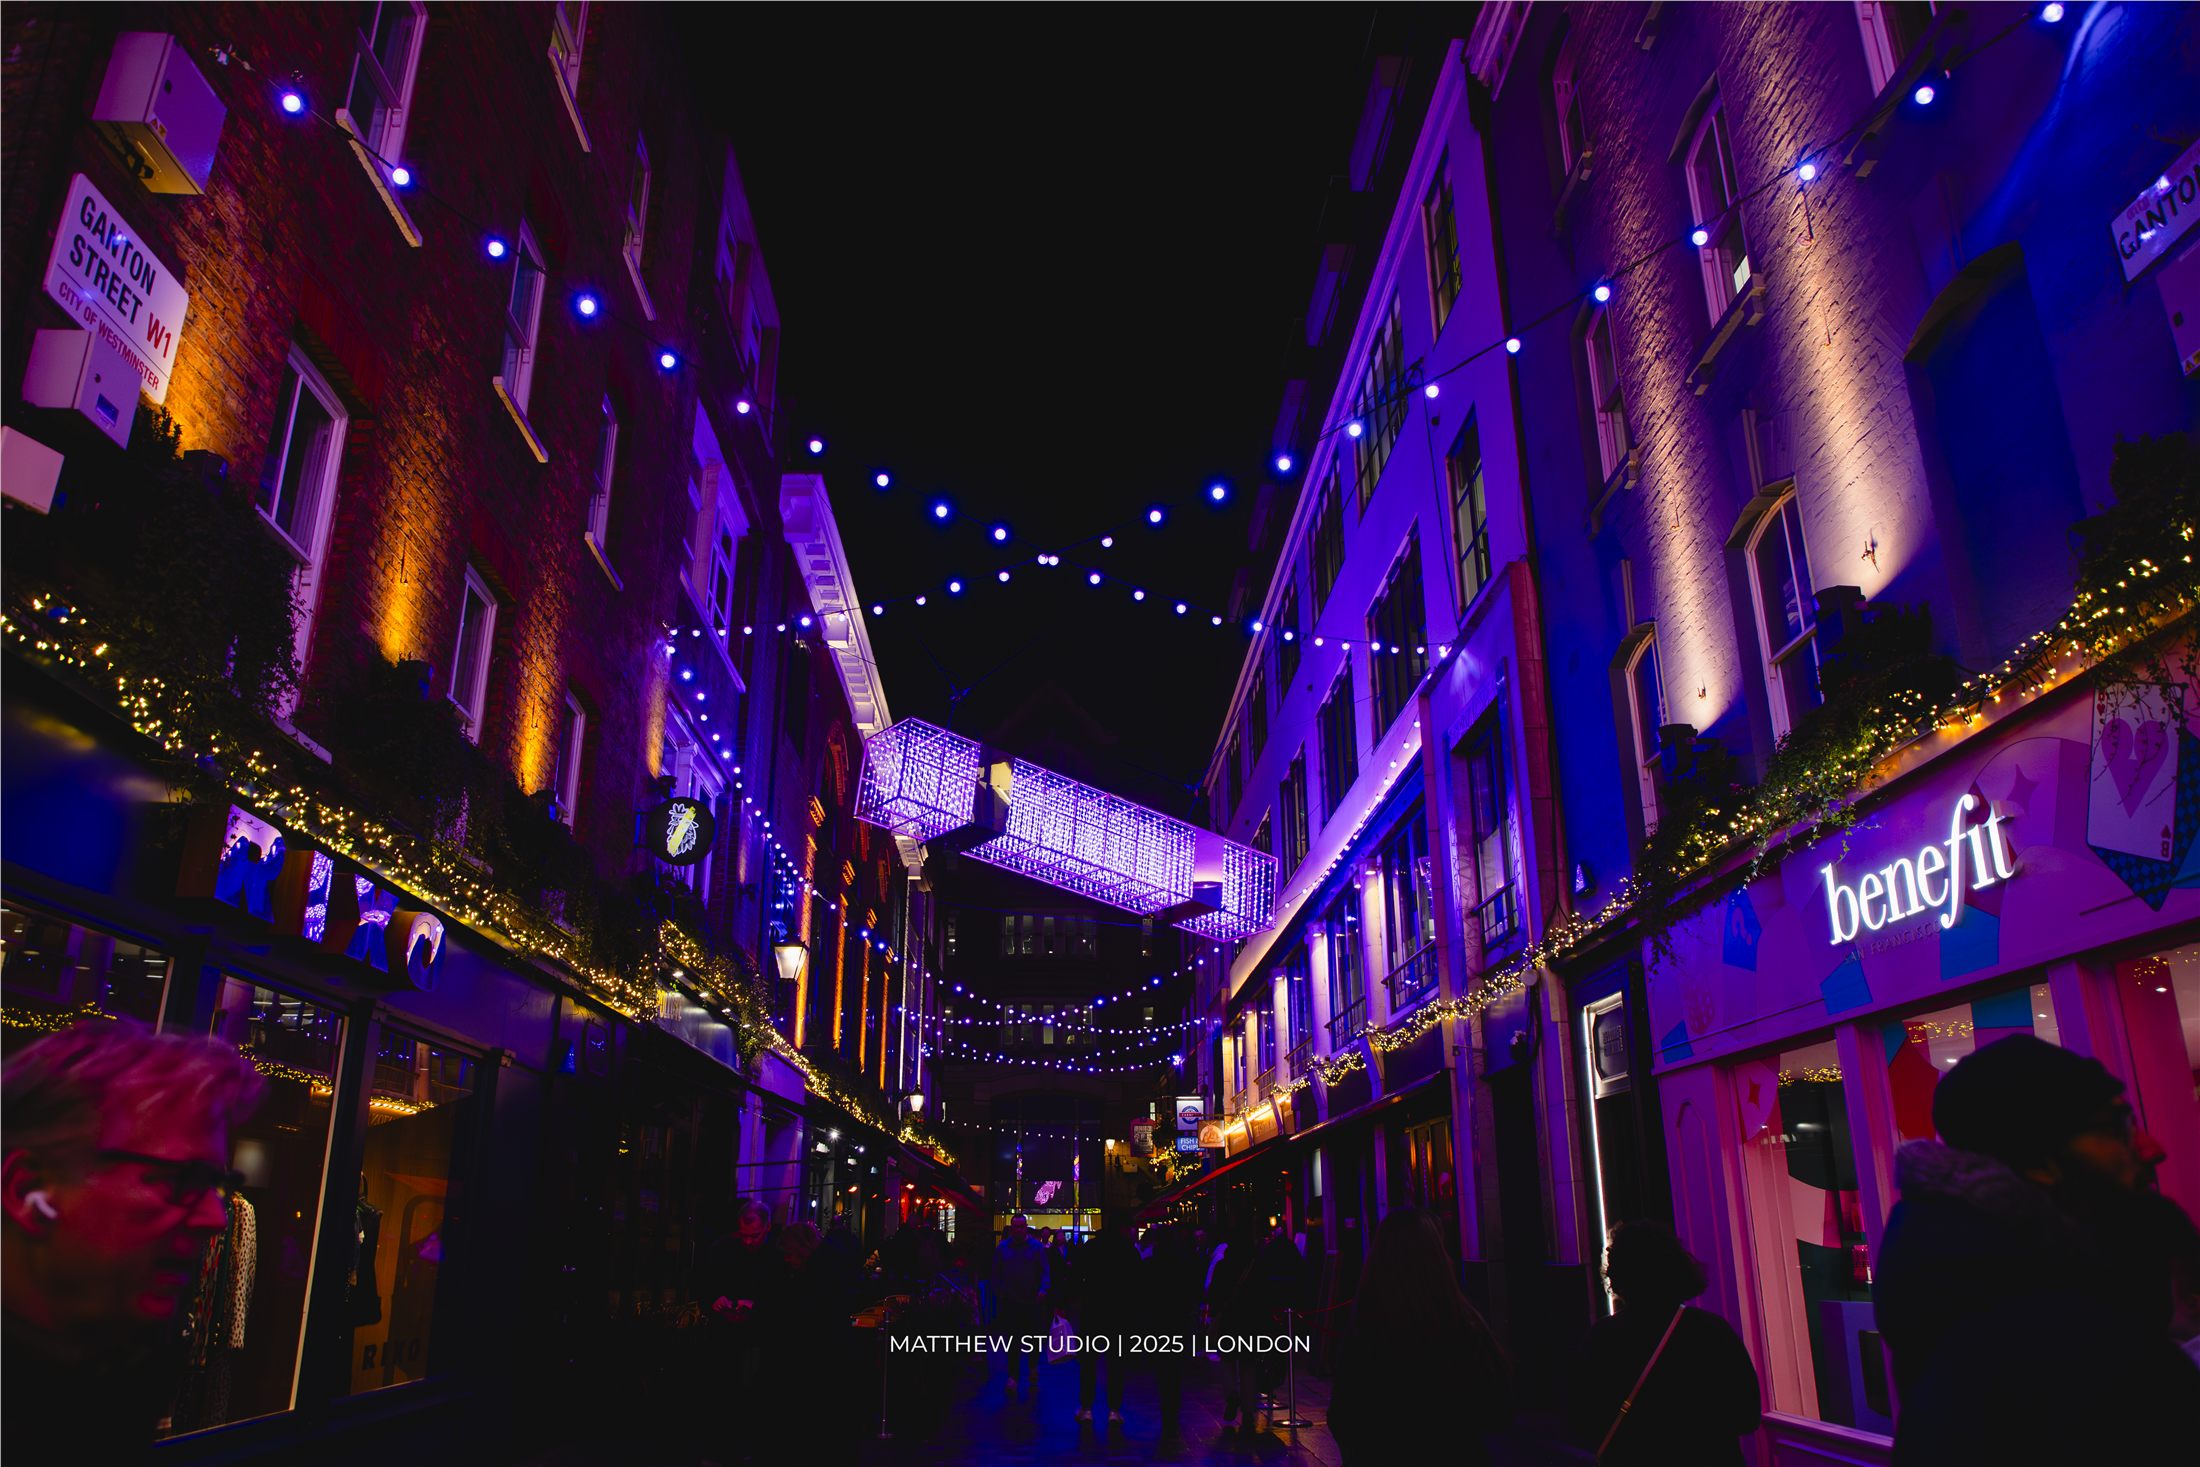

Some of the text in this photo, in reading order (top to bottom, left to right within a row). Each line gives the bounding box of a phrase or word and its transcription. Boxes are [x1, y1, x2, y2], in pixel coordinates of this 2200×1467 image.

[69, 233, 143, 325] STREET
[79, 195, 157, 296] GANTON
[59, 281, 85, 312] CITY
[83, 305, 98, 326] OF
[98, 319, 160, 391] WESTMINSTER
[146, 311, 172, 359] W1
[214, 803, 447, 992] RIXO
[1821, 793, 2015, 945] benefit
